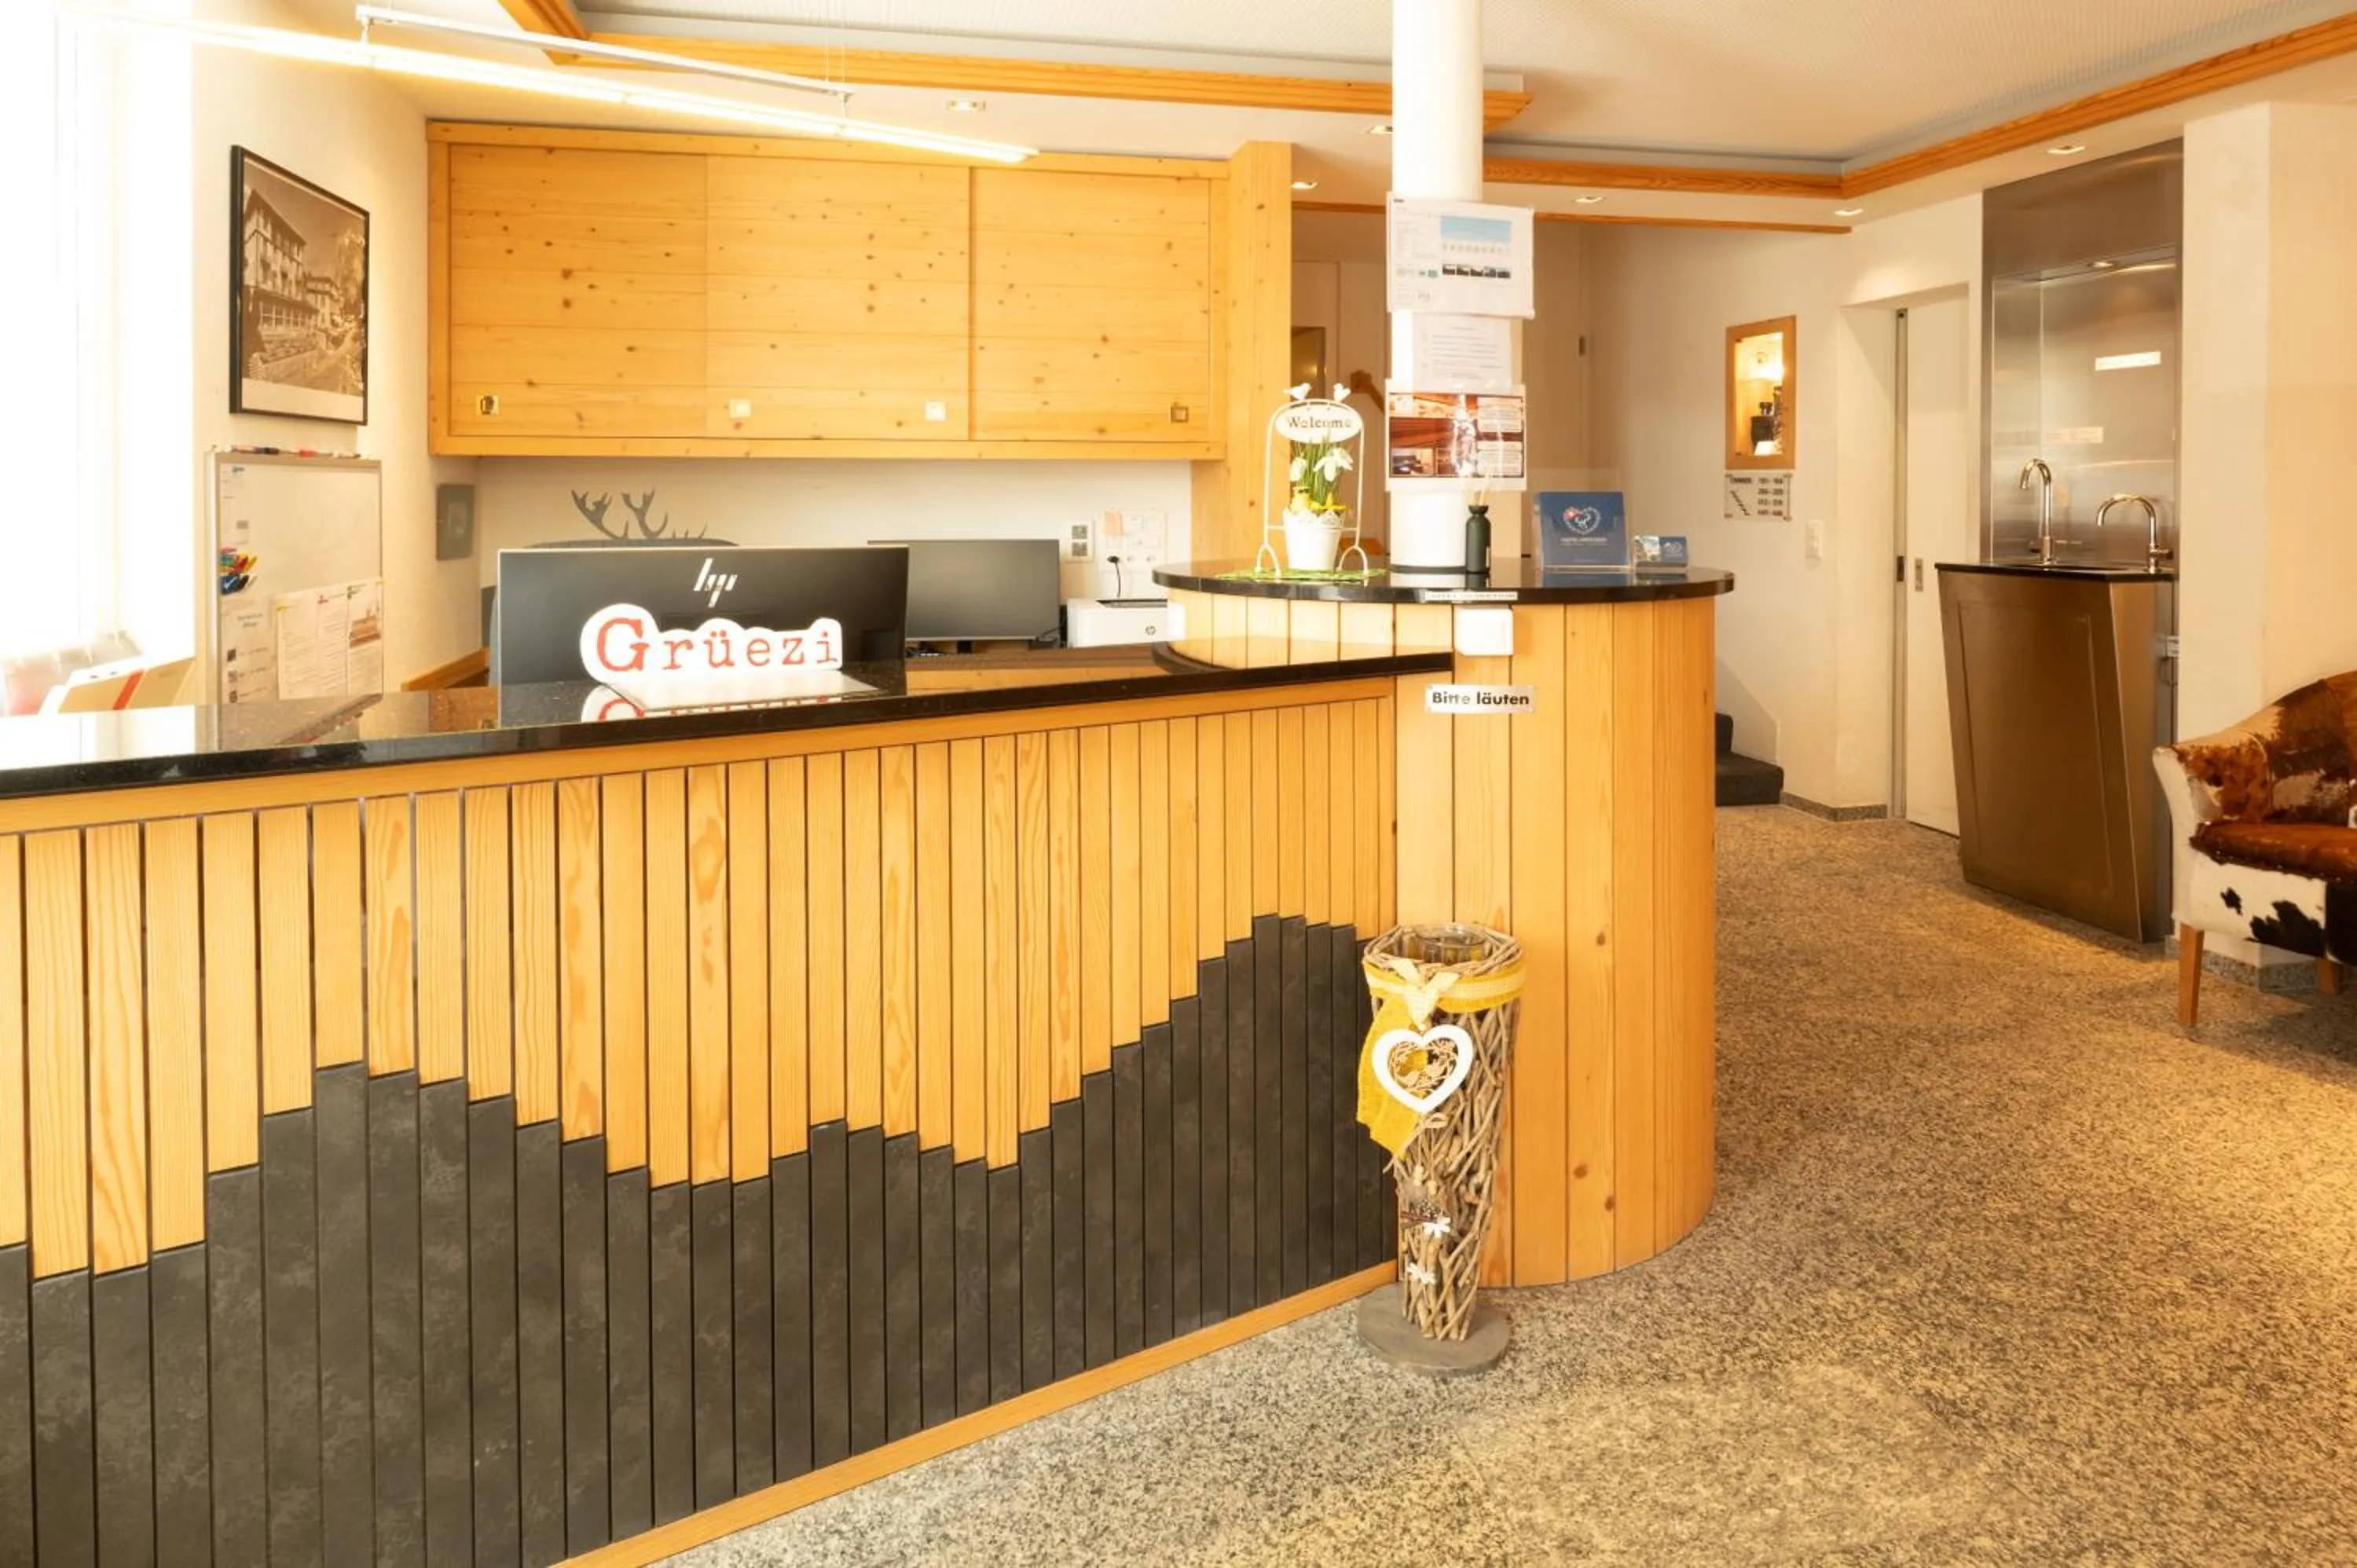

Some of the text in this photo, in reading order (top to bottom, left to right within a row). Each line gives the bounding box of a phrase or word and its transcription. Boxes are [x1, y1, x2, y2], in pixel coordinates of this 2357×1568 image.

[1285, 416, 1352, 428] Welcome
[693, 557, 738, 608] hp
[596, 617, 838, 672] Grüezi
[1432, 691, 1530, 705] Bitte läuten
